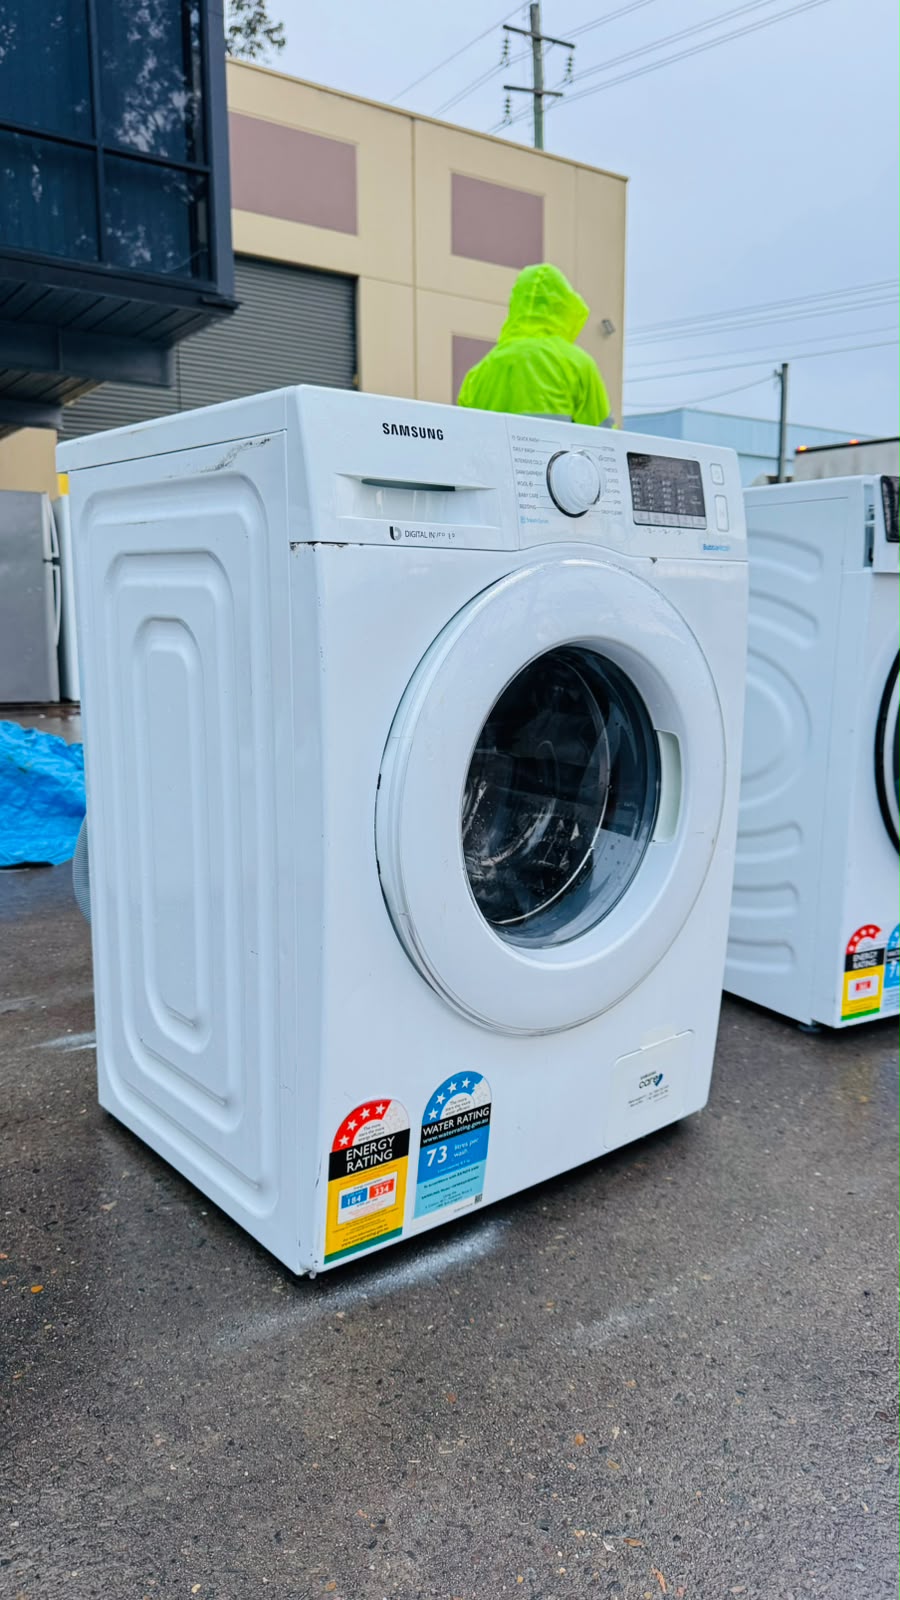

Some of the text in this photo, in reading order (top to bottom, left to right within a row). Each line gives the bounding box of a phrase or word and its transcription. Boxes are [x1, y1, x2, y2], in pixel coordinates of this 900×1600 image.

[382, 422, 444, 440] SAMSUNG
[404, 530, 428, 539] DIGITAL
[423, 1107, 489, 1137] WATER RATING
[346, 1135, 395, 1162] ENERGY
[426, 1145, 448, 1168] 73
[346, 1149, 393, 1174] RATING
[347, 1194, 362, 1206] 184
[374, 1185, 390, 1197] 334
